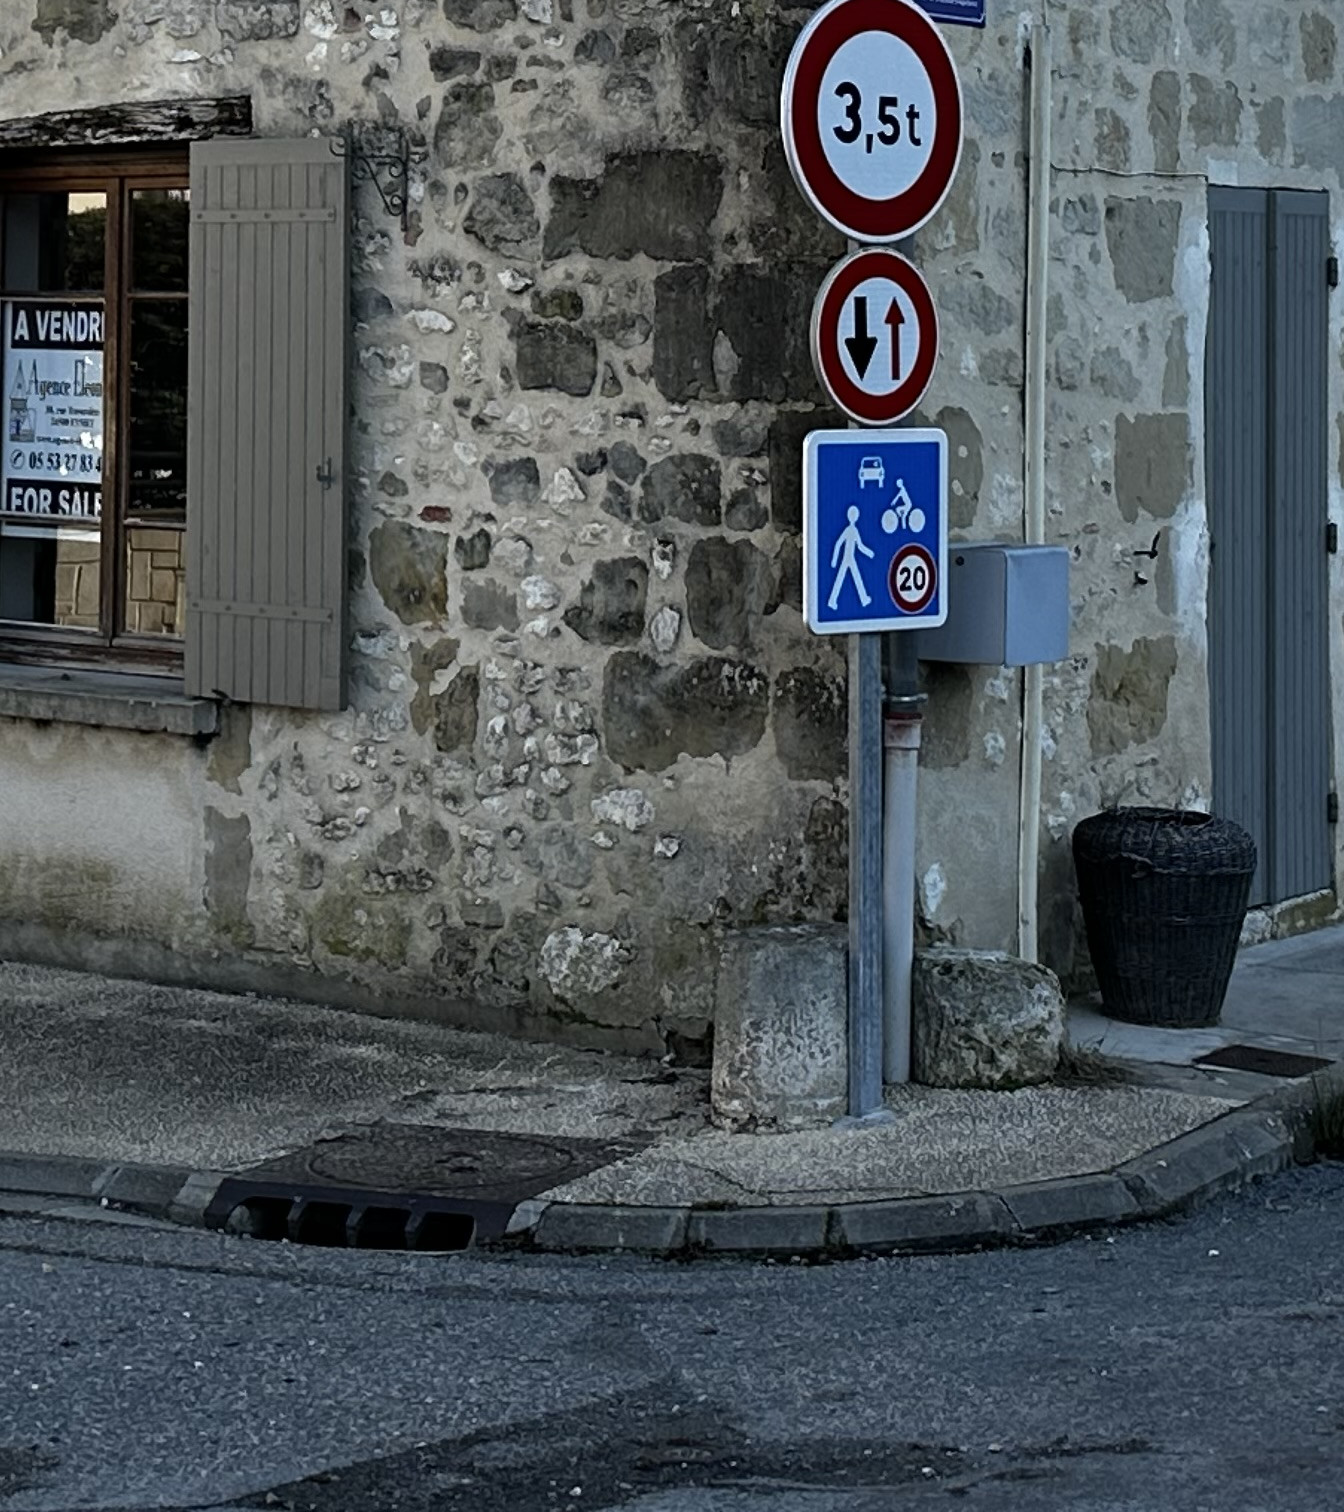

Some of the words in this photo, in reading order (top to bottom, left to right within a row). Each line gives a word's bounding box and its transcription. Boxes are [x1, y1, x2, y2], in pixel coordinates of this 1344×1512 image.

[833, 81, 922, 154] 3,5t
[14, 310, 29, 341] A
[29, 451, 44, 470] 05
[47, 452, 61, 471] 53
[11, 486, 53, 515] FOR
[899, 565, 926, 591] 20
